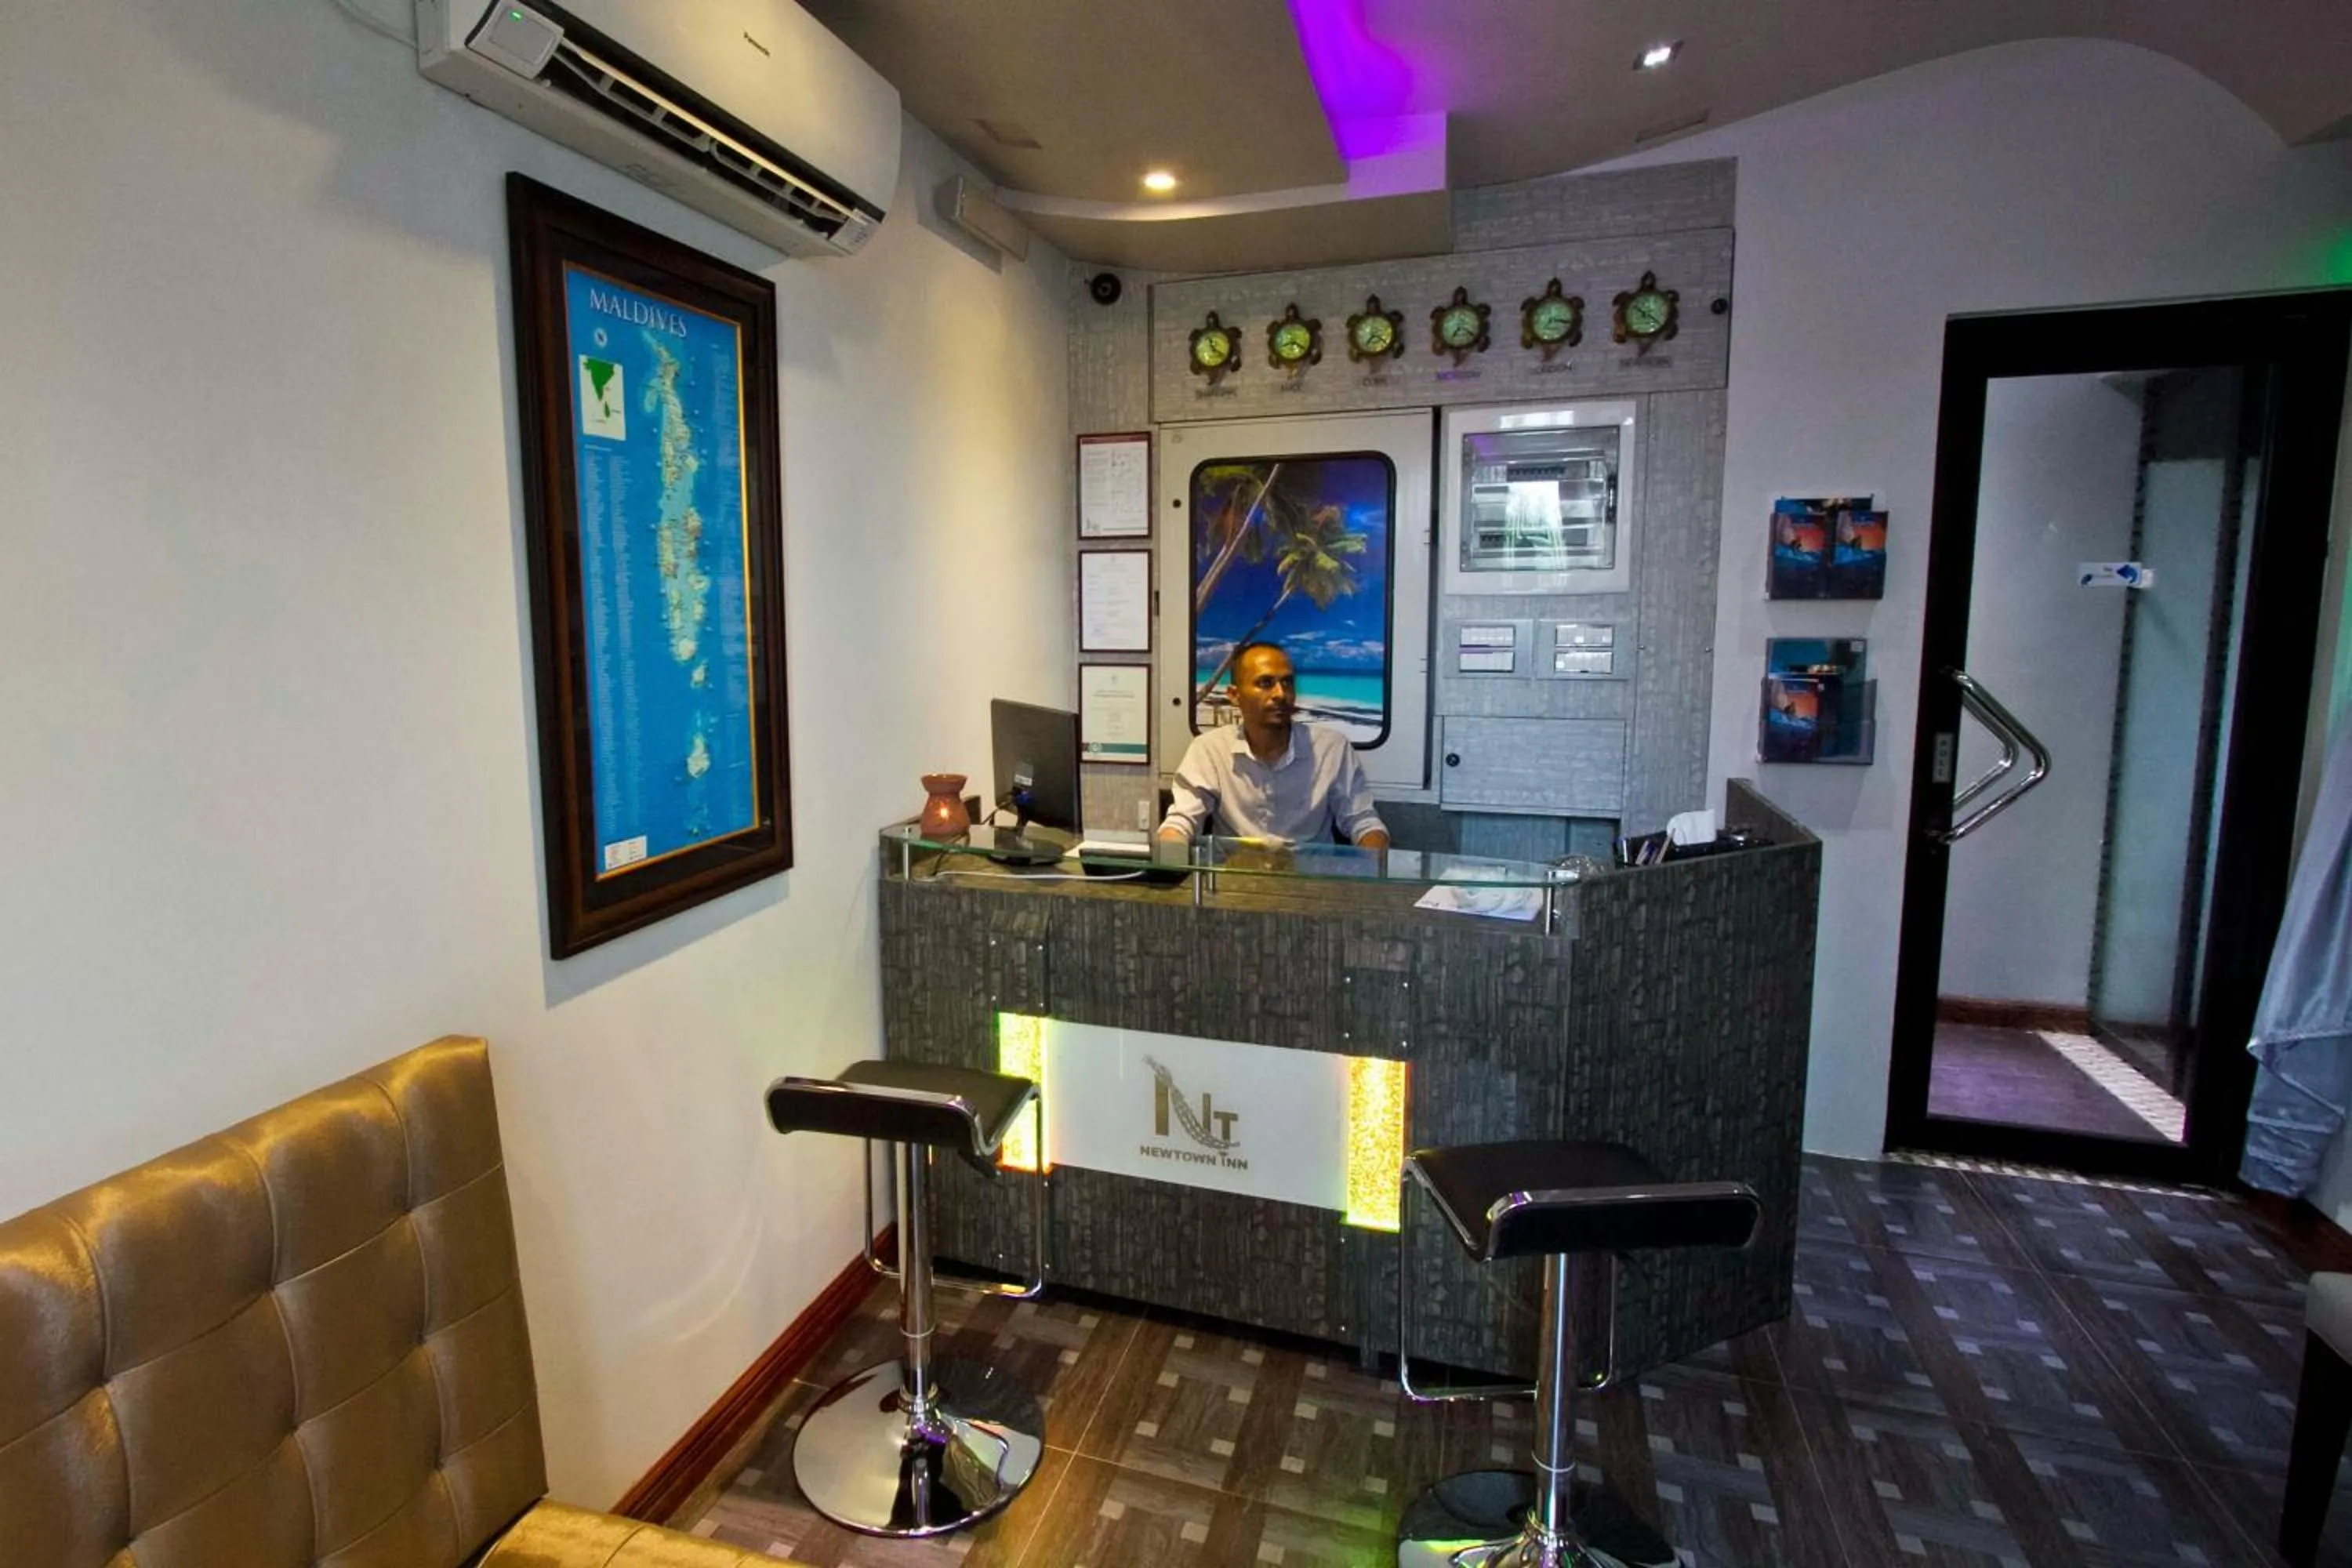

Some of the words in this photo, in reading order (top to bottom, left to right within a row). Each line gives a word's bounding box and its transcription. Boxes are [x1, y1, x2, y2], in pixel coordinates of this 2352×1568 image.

[590, 288, 687, 338] MALDIVES
[1140, 1145, 1216, 1167] NEWTOWN
[1221, 1156, 1249, 1171] INN
